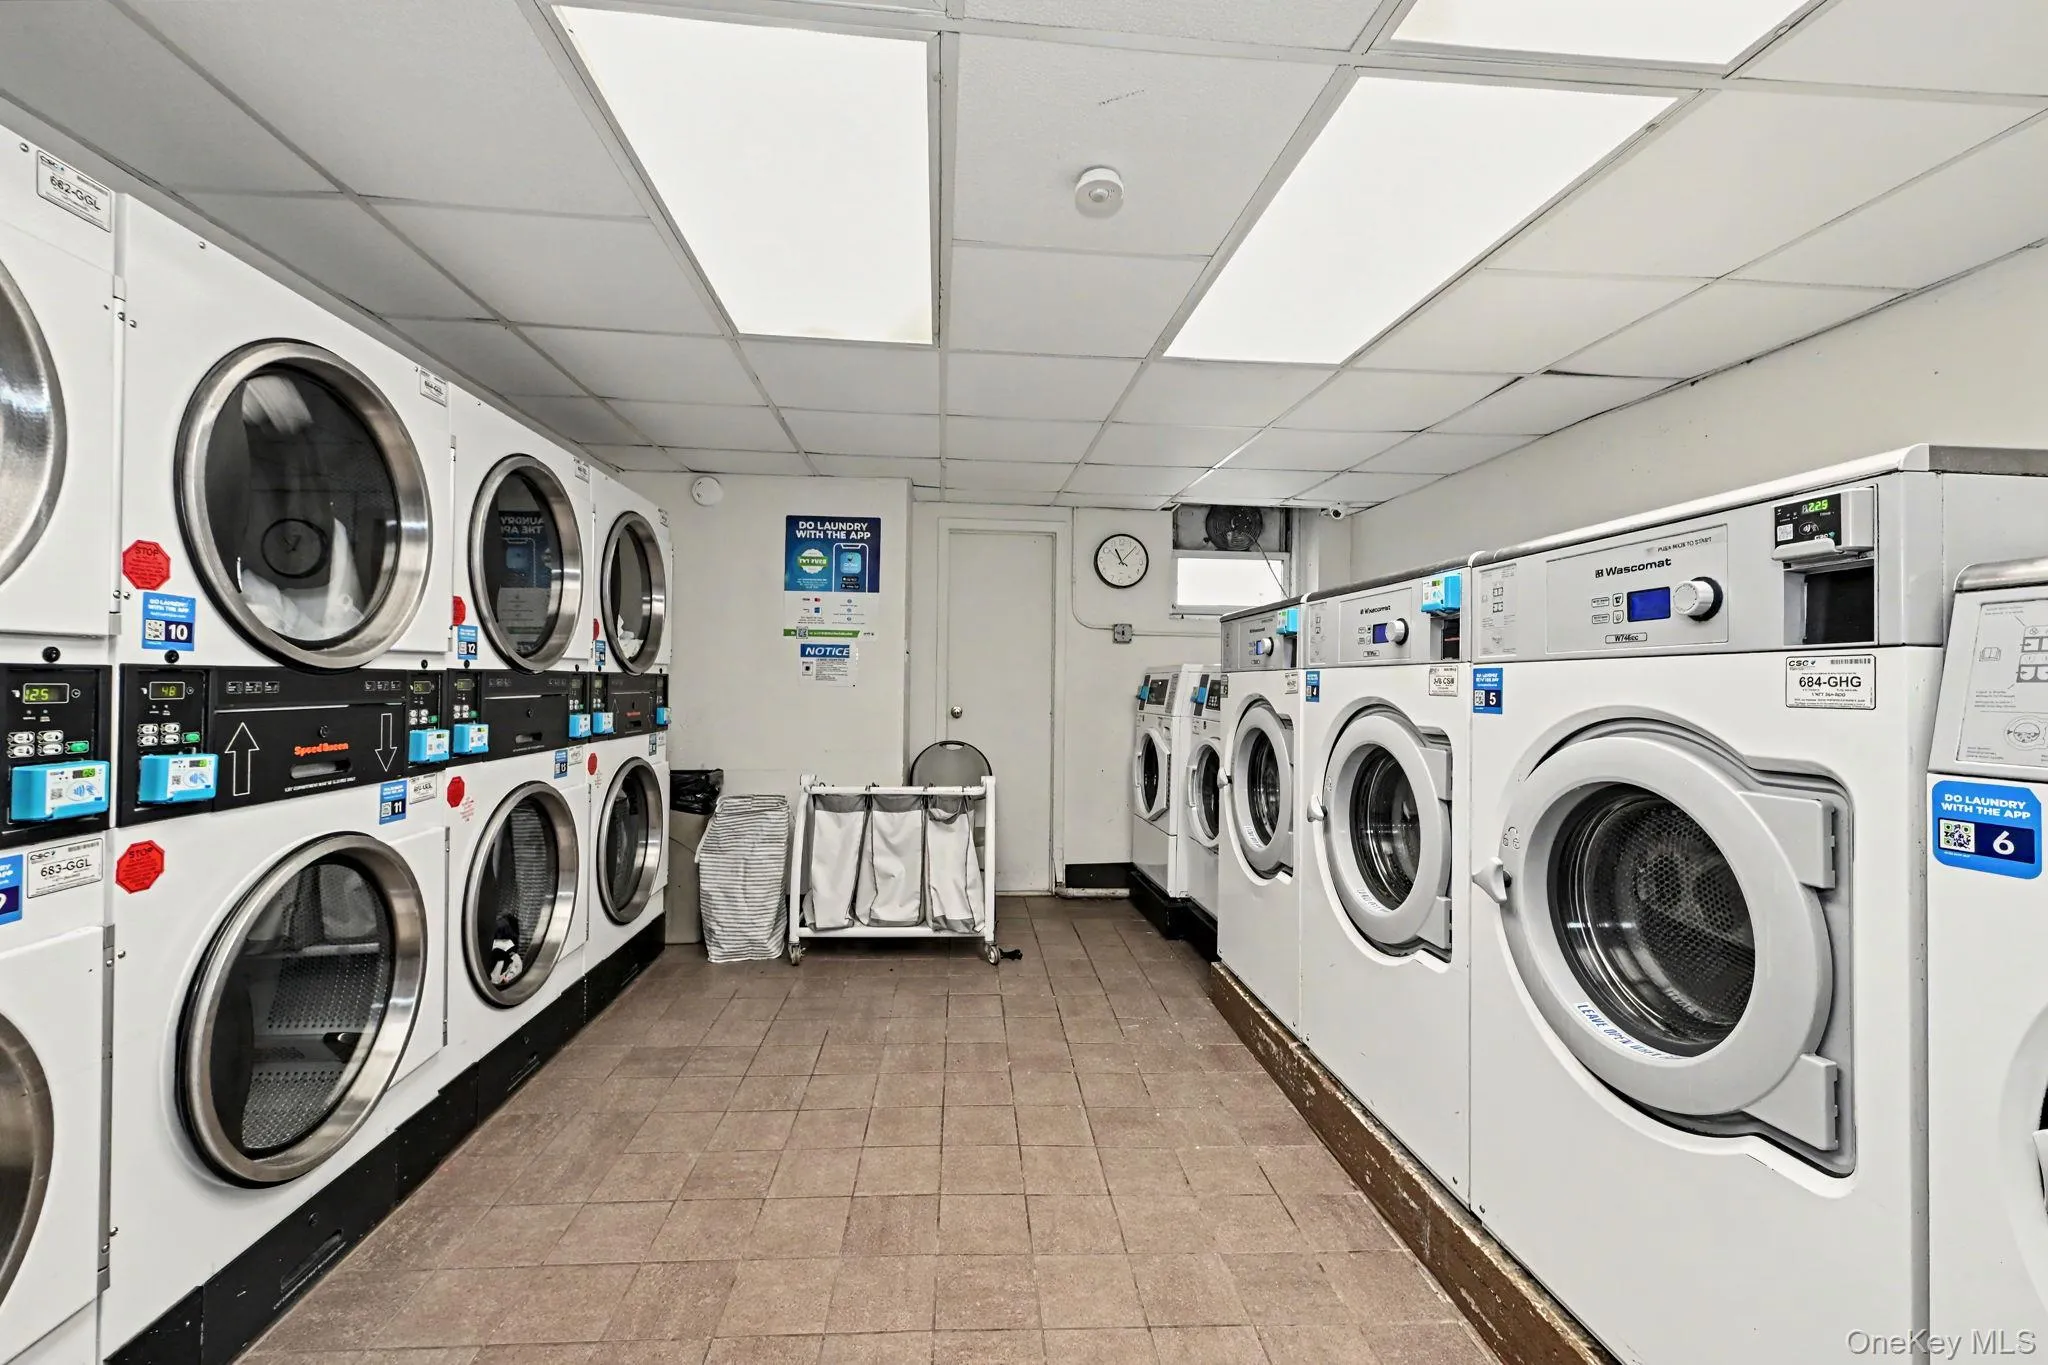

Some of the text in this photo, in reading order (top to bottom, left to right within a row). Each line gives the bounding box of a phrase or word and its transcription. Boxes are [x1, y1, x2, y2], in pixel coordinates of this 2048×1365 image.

[50, 176, 101, 210] 682-GGL
[799, 521, 868, 531] DO LAUNDRY
[796, 530, 871, 540] WITH THE APP
[135, 546, 159, 556] STOP
[1606, 558, 1671, 577] Wascomat
[168, 624, 188, 641] 10
[805, 646, 850, 656] NOTICE
[1789, 659, 1809, 667] CSC
[1799, 676, 1862, 688] 684-GHG
[1489, 692, 1497, 706] 5
[394, 801, 402, 813] 11
[1944, 793, 2026, 810] DO LAUNDRY
[1941, 802, 2031, 820] WITH THE APP
[1992, 830, 2015, 855] 6
[41, 858, 92, 877] 683-GGL
